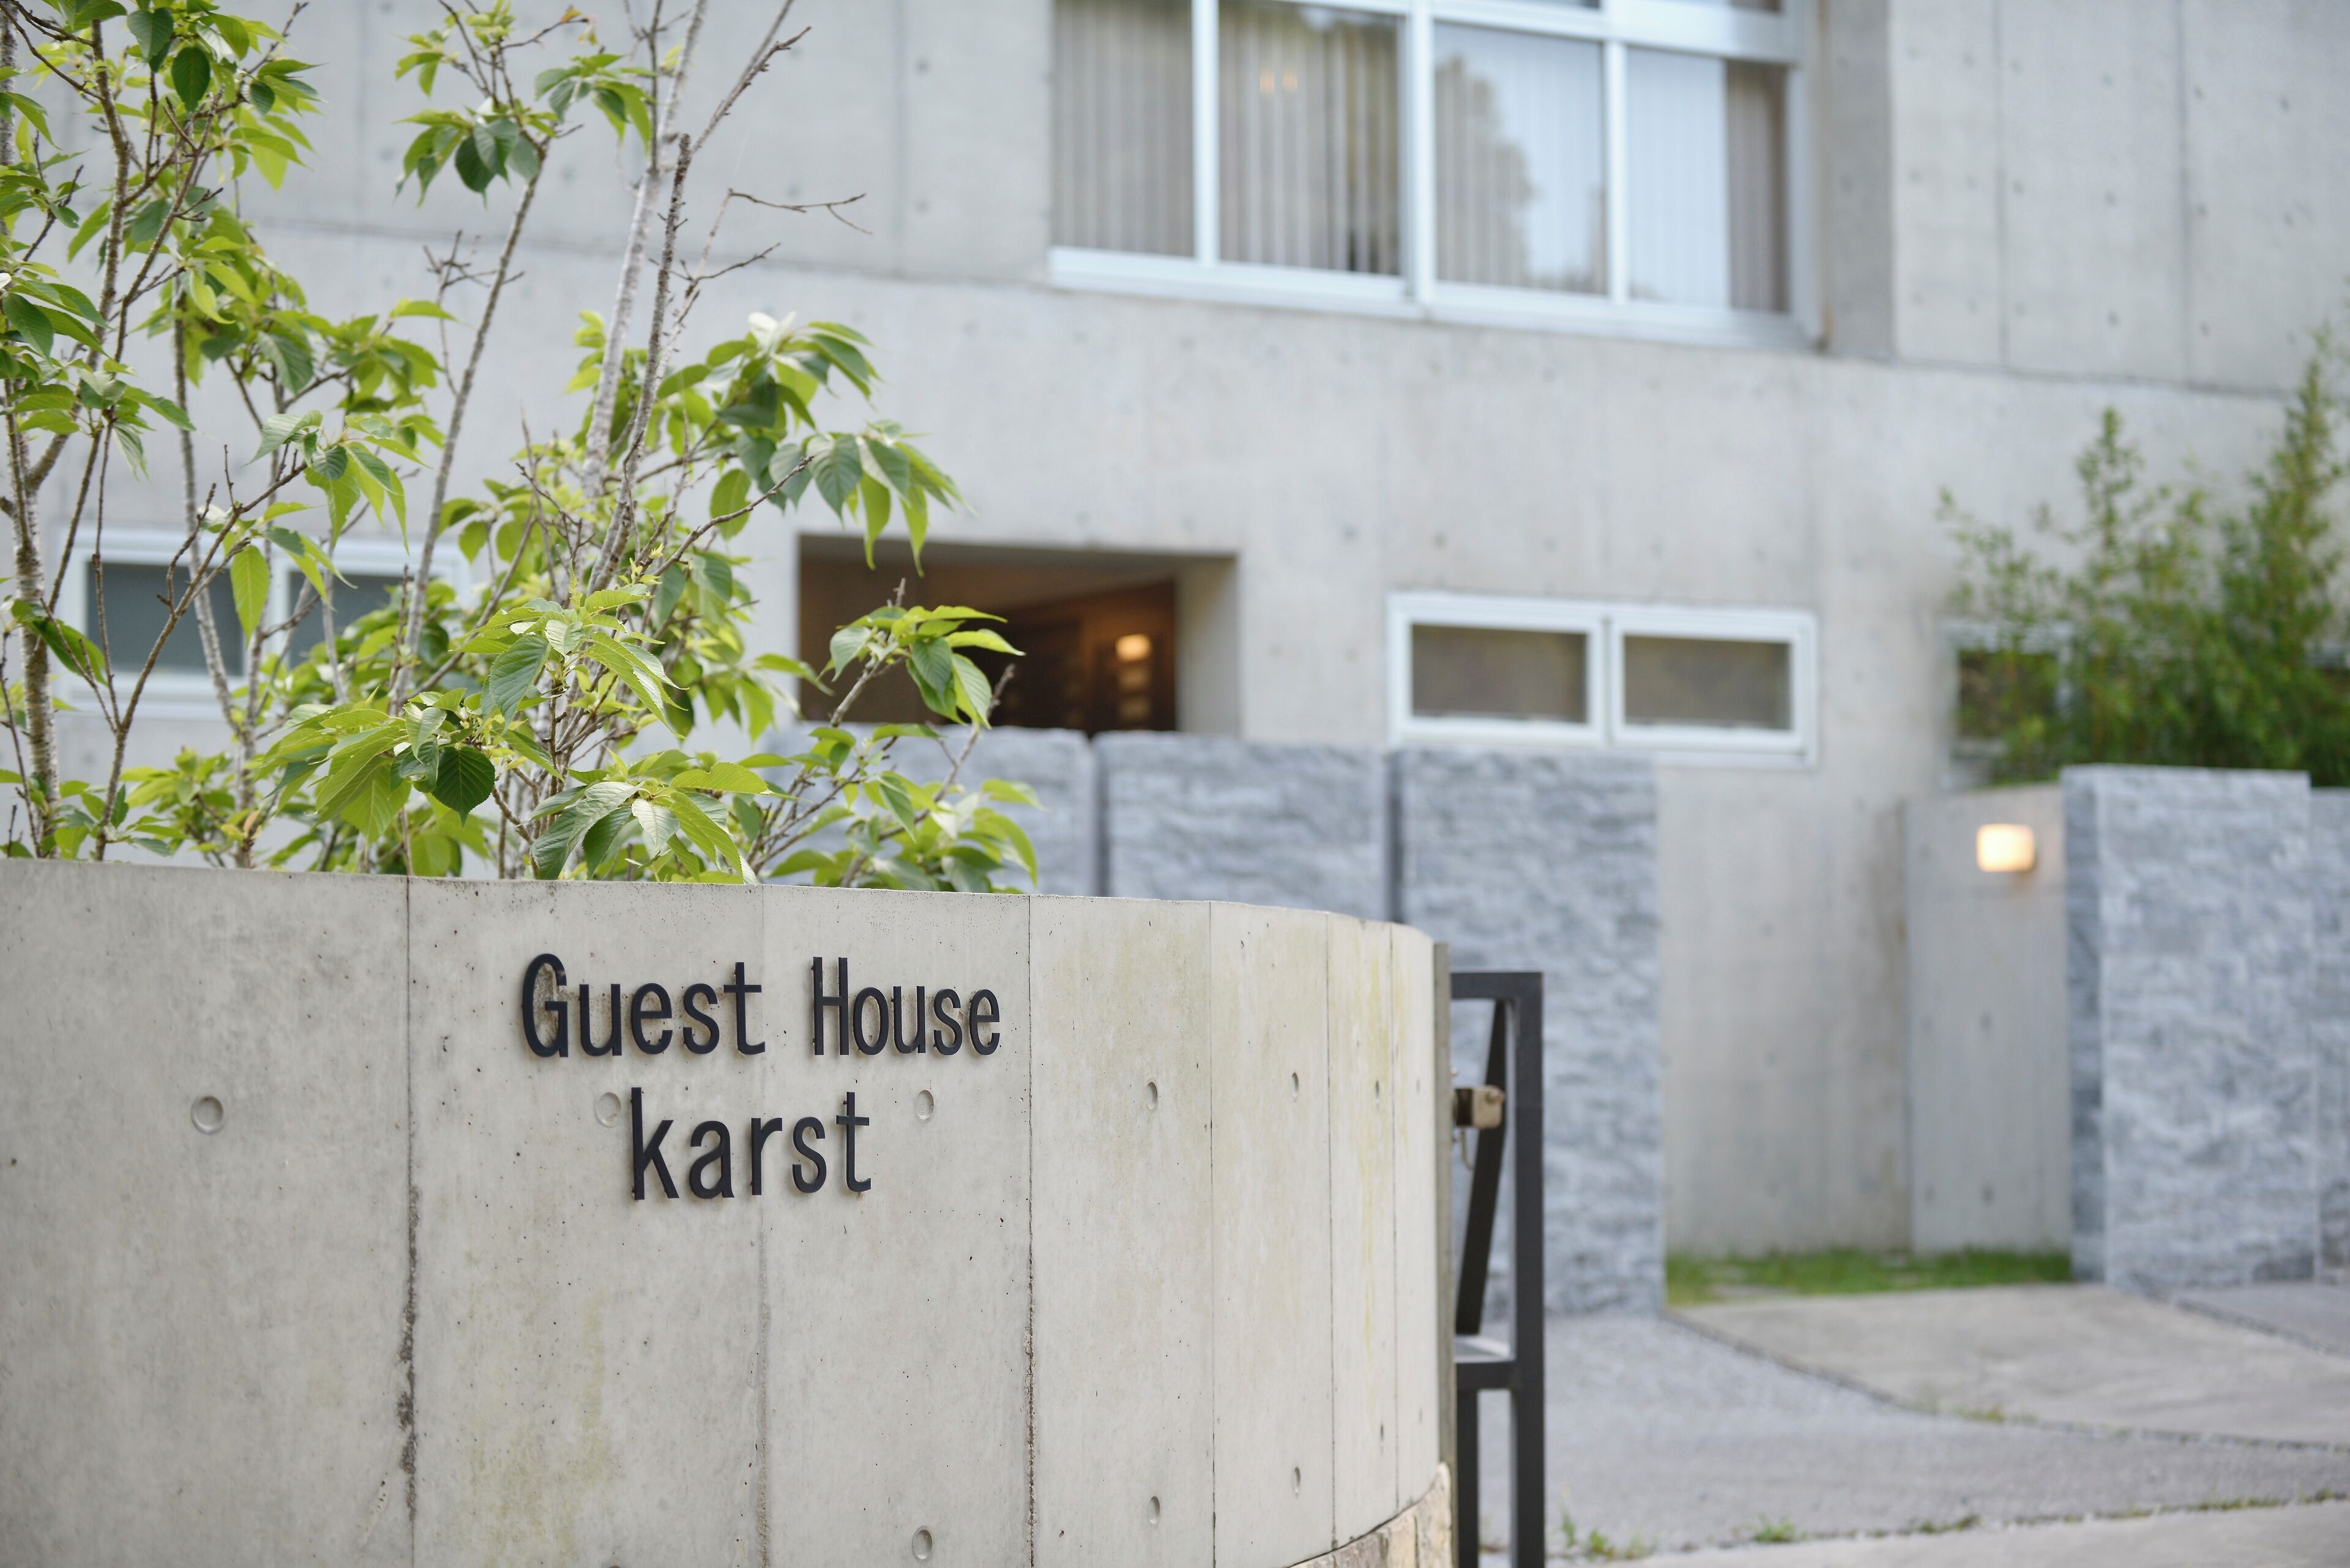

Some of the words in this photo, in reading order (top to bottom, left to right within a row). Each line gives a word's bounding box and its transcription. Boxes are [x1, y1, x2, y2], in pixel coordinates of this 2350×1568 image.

[522, 953, 765, 1058] Guest
[812, 957, 1001, 1056] House
[630, 1087, 871, 1201] karst
